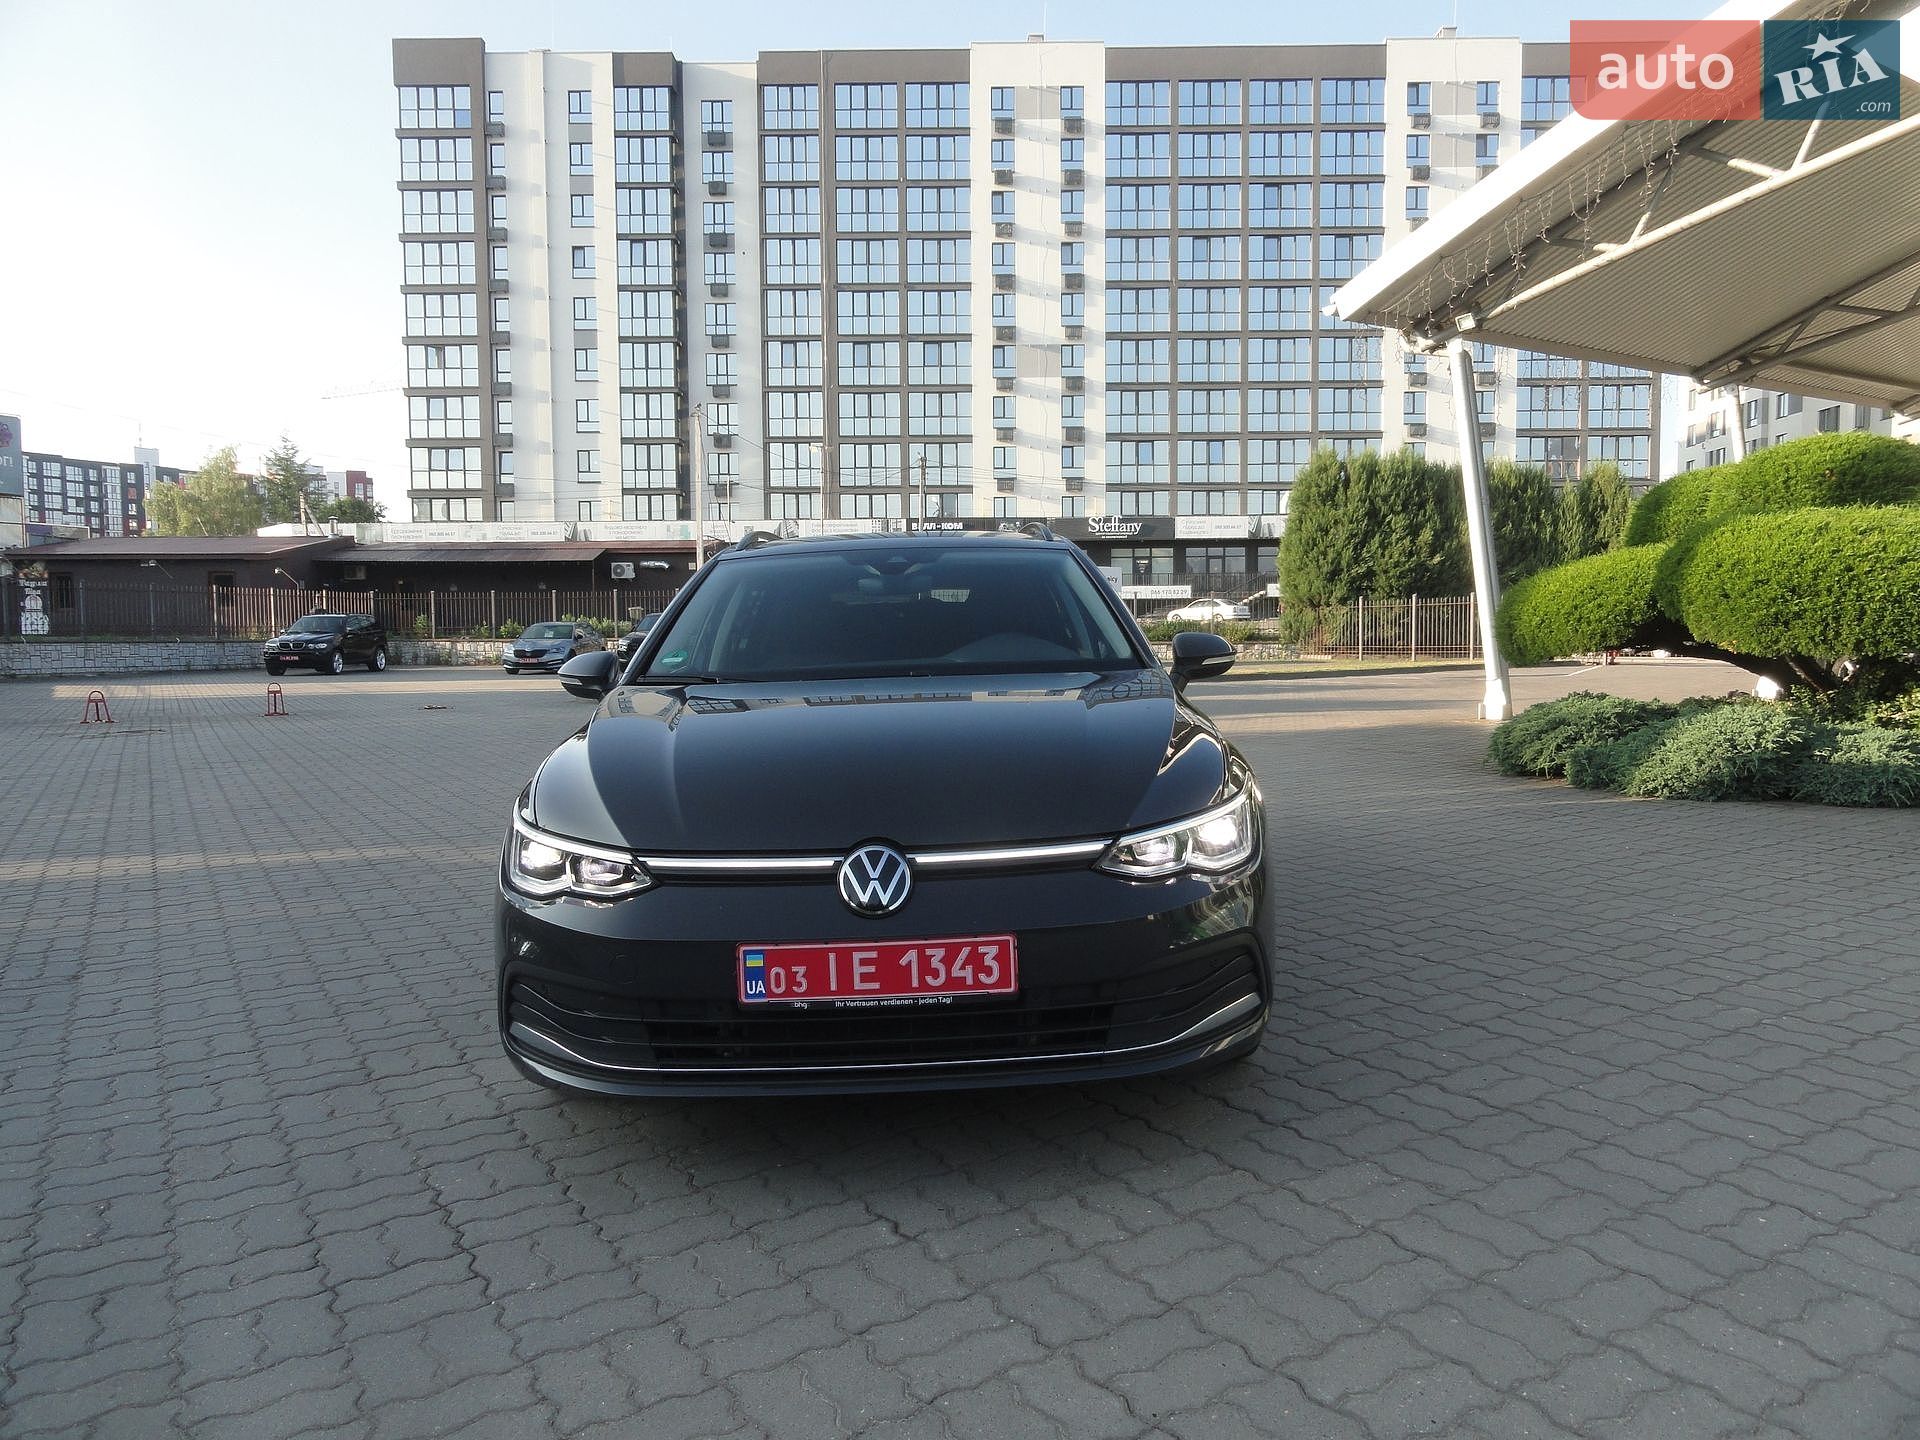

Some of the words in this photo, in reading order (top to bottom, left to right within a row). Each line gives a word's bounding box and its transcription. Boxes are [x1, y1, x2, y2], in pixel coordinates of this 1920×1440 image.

[1088, 515, 1143, 535] Steffany
[769, 966, 808, 995] 03
[828, 951, 880, 991] IE
[899, 945, 1000, 988] 1343
[746, 980, 766, 995] UA
[794, 1001, 808, 1010] bhg
[835, 1000, 844, 1008] Ihr
[845, 999, 878, 1007] Vertrauen
[879, 998, 913, 1006] verdienen
[918, 997, 937, 1005] jeden
[938, 996, 953, 1004] Tag!
